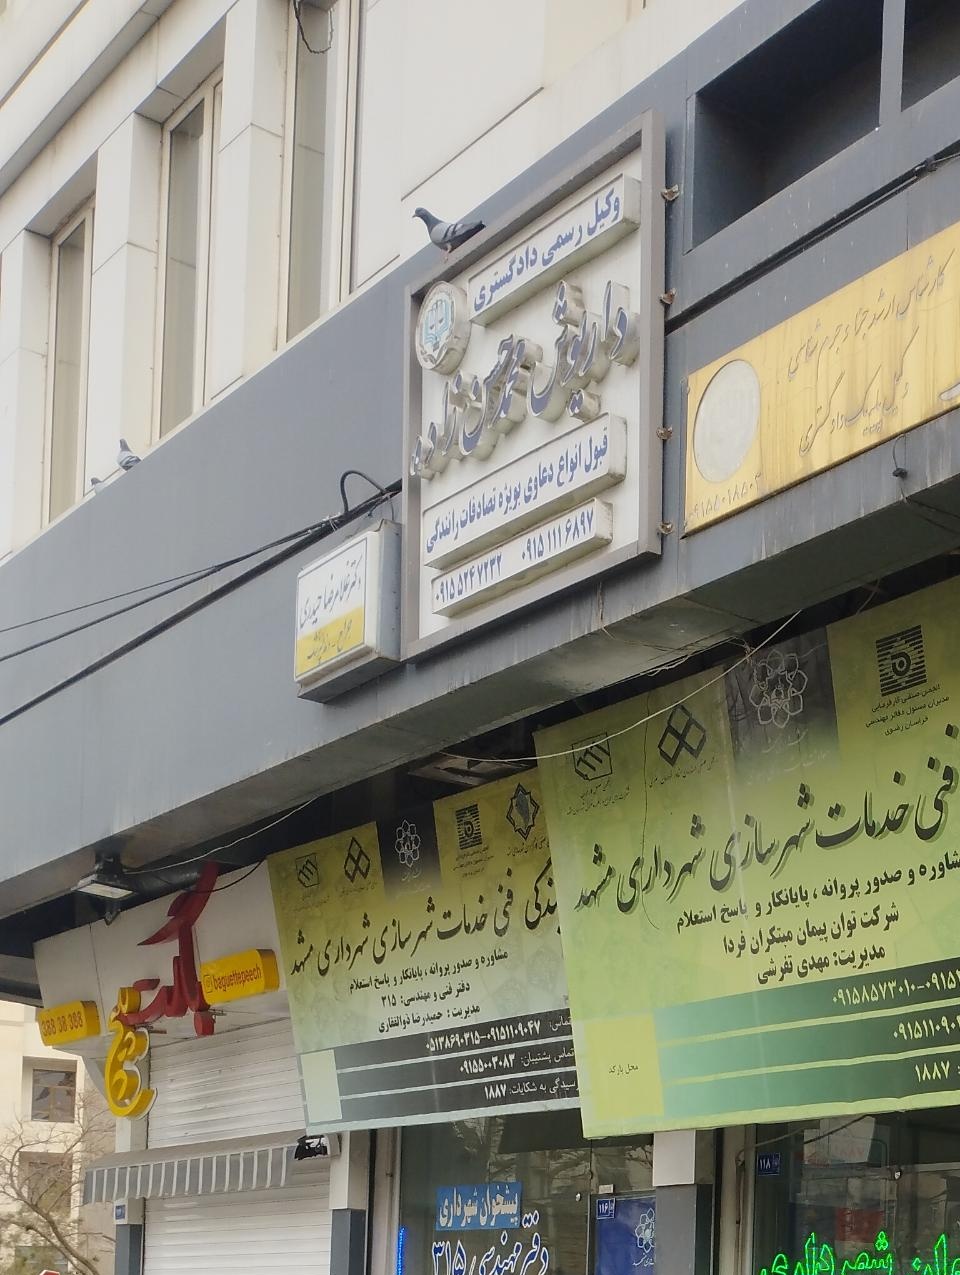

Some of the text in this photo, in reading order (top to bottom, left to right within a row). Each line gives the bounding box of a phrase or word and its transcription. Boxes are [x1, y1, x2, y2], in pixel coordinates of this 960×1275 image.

[474, 187, 620, 312] وکیل رسمی دادگستری
[557, 442, 582, 487] انواع
[584, 426, 608, 473] قبول
[523, 461, 554, 503] دعاوی
[460, 488, 496, 529] تصادفات
[426, 508, 460, 553] رانندگی
[915, 723, 957, 842] فنی
[816, 771, 910, 848] خدمات
[573, 843, 617, 912] مشهد
[617, 813, 706, 914] شهرداری
[865, 869, 902, 895] صدور
[908, 869, 915, 886] و
[493, 867, 514, 938] فنی
[756, 902, 762, 917] و
[766, 885, 809, 914] پایانکار
[822, 879, 860, 901] پروانه
[436, 894, 488, 940] خدمات
[677, 906, 717, 934] استعلام
[720, 900, 748, 923] پاسخ
[723, 902, 900, 958] شرکت توان پیمان مبتکران فردا
[290, 928, 314, 976] مشهد
[316, 912, 371, 977] شهرداری
[480, 948, 509, 967] مشاوره
[757, 943, 886, 985] مدیریت: مهدی تفرشی
[453, 959, 473, 975] صدور
[455, 979, 470, 997] دفتر
[438, 982, 453, 1000] فنی
[484, 1084, 507, 1101] ۱۸۸۷
[914, 1060, 950, 1083] ۱۸۸۷
[760, 1158, 771, 1170] ۱۱۸
[439, 1184, 519, 1227] پیشخوان شهرداری
